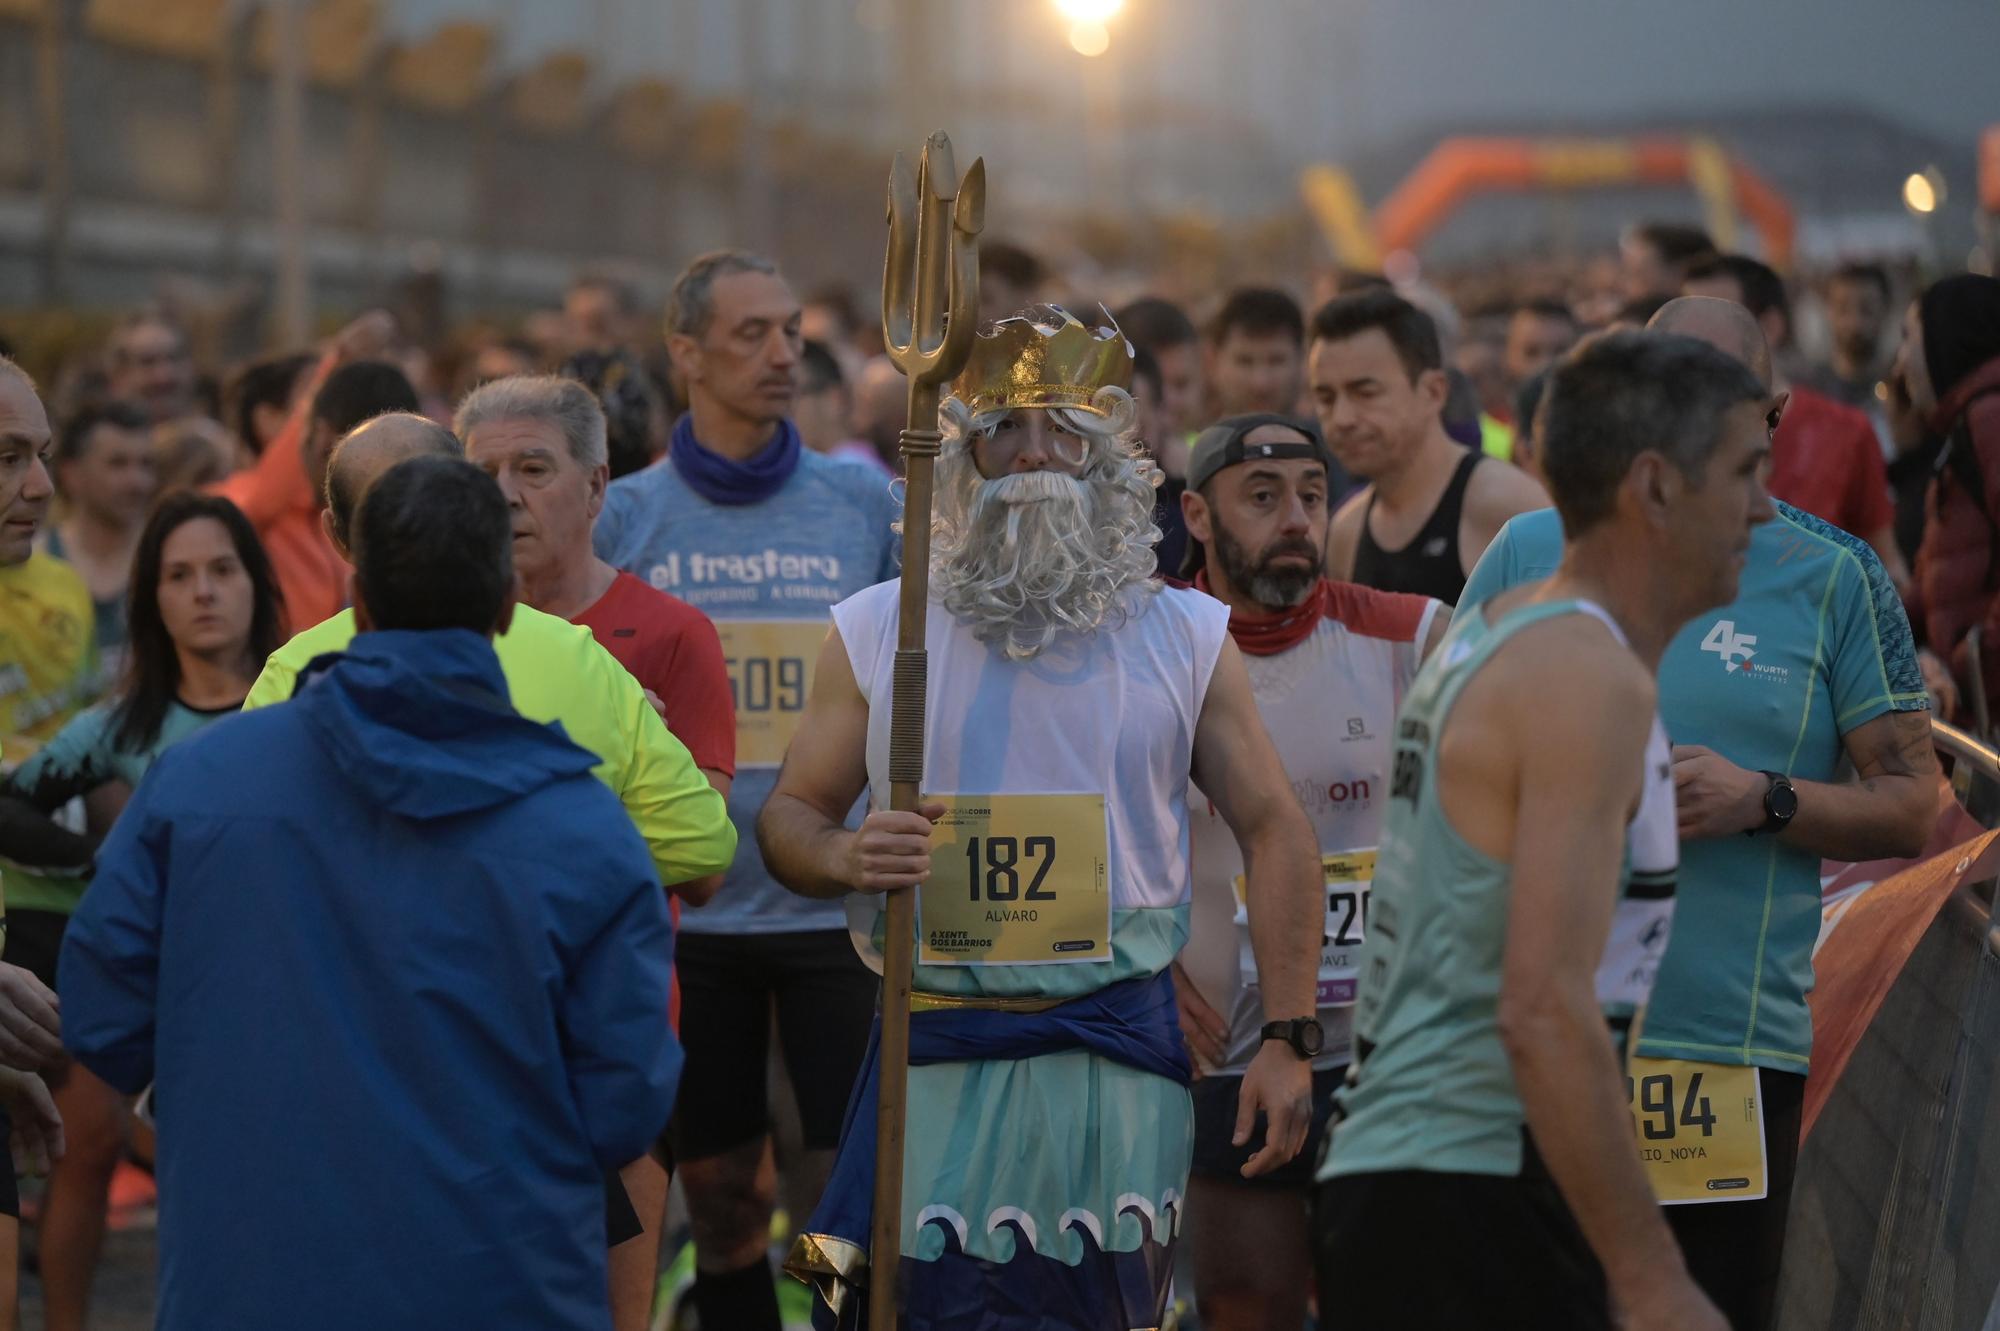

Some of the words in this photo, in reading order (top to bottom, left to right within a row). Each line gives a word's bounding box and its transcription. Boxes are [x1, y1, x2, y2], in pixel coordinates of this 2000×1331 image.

[650, 552, 681, 589] el
[690, 549, 840, 583] trastero
[966, 836, 1057, 902] 182
[985, 909, 1038, 922] ALVARO
[939, 931, 969, 939] XENTE
[951, 939, 993, 947] BARRIOS
